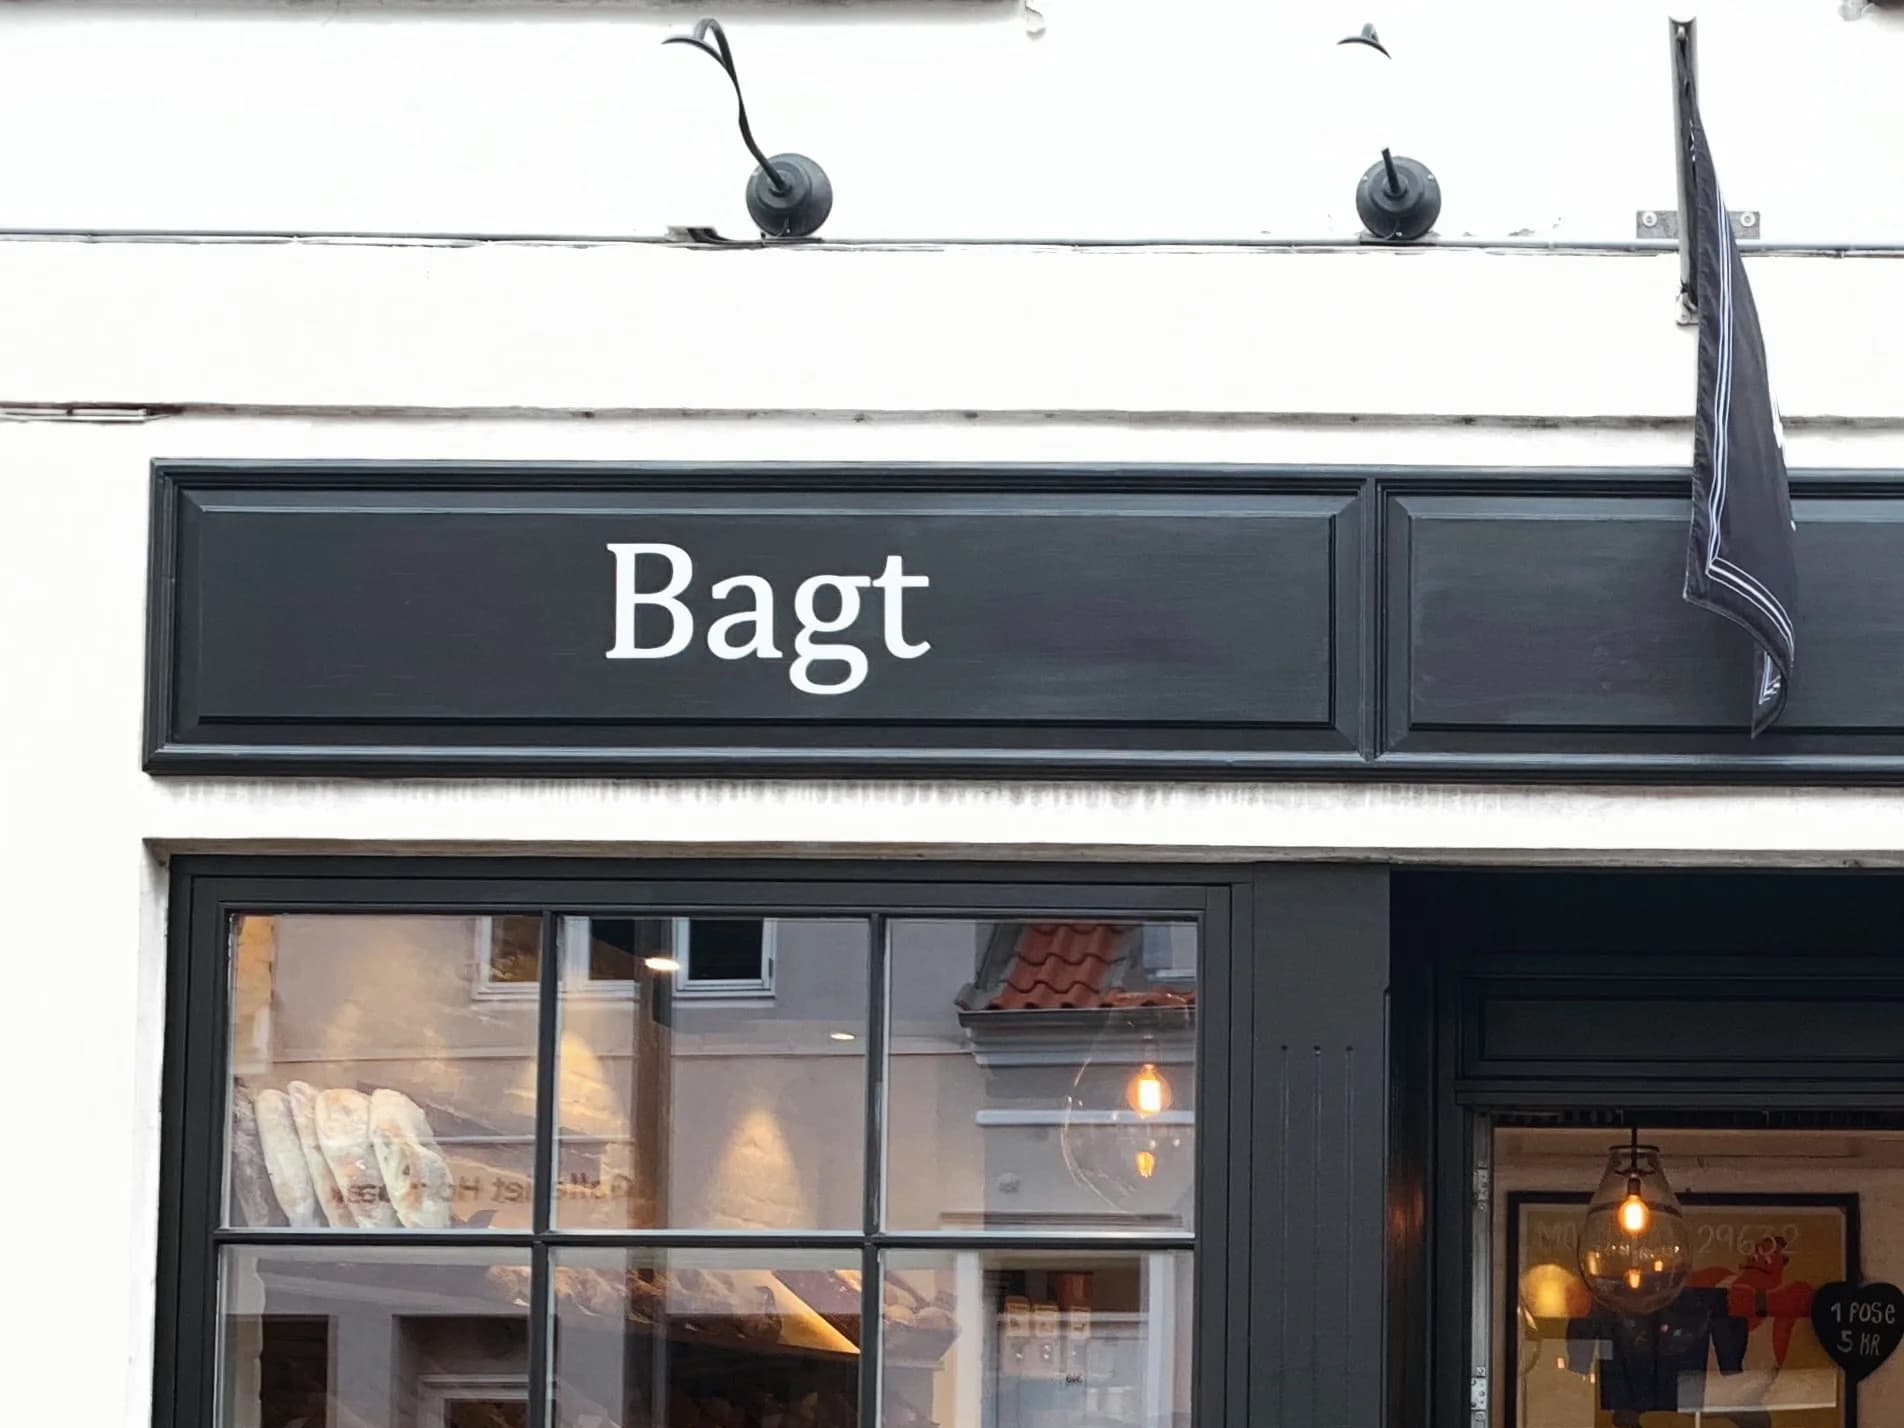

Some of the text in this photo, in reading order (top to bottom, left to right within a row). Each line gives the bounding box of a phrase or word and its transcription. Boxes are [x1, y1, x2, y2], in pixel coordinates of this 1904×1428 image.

[604, 541, 933, 697] Bagt
[1830, 1302, 1842, 1323] 1
[1836, 1329, 1881, 1356] 5 KR
